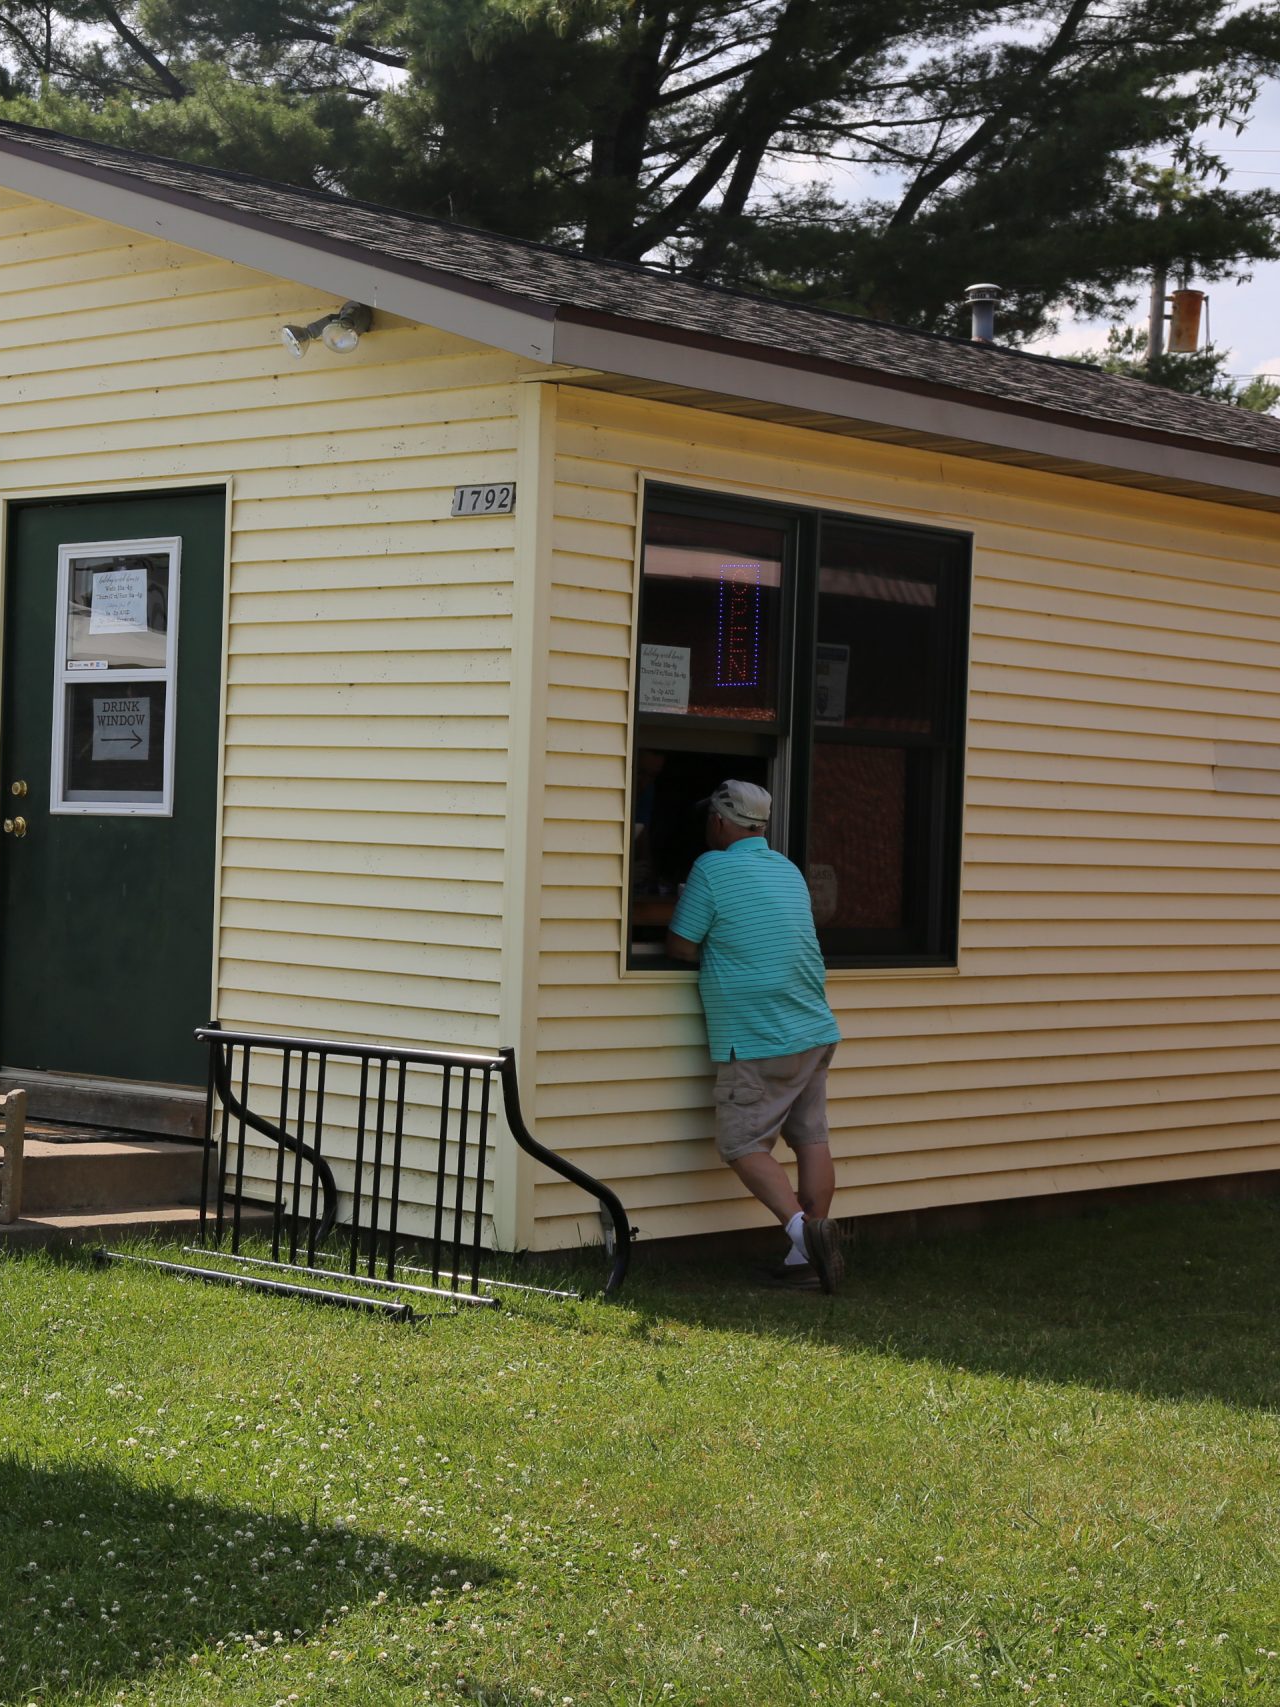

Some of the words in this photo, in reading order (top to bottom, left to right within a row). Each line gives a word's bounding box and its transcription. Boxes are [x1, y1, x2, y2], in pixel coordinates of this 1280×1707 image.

[457, 487, 510, 511] 1792
[728, 569, 748, 682] OPEN
[102, 700, 140, 713] DRINK
[96, 714, 145, 727] WINDOW
